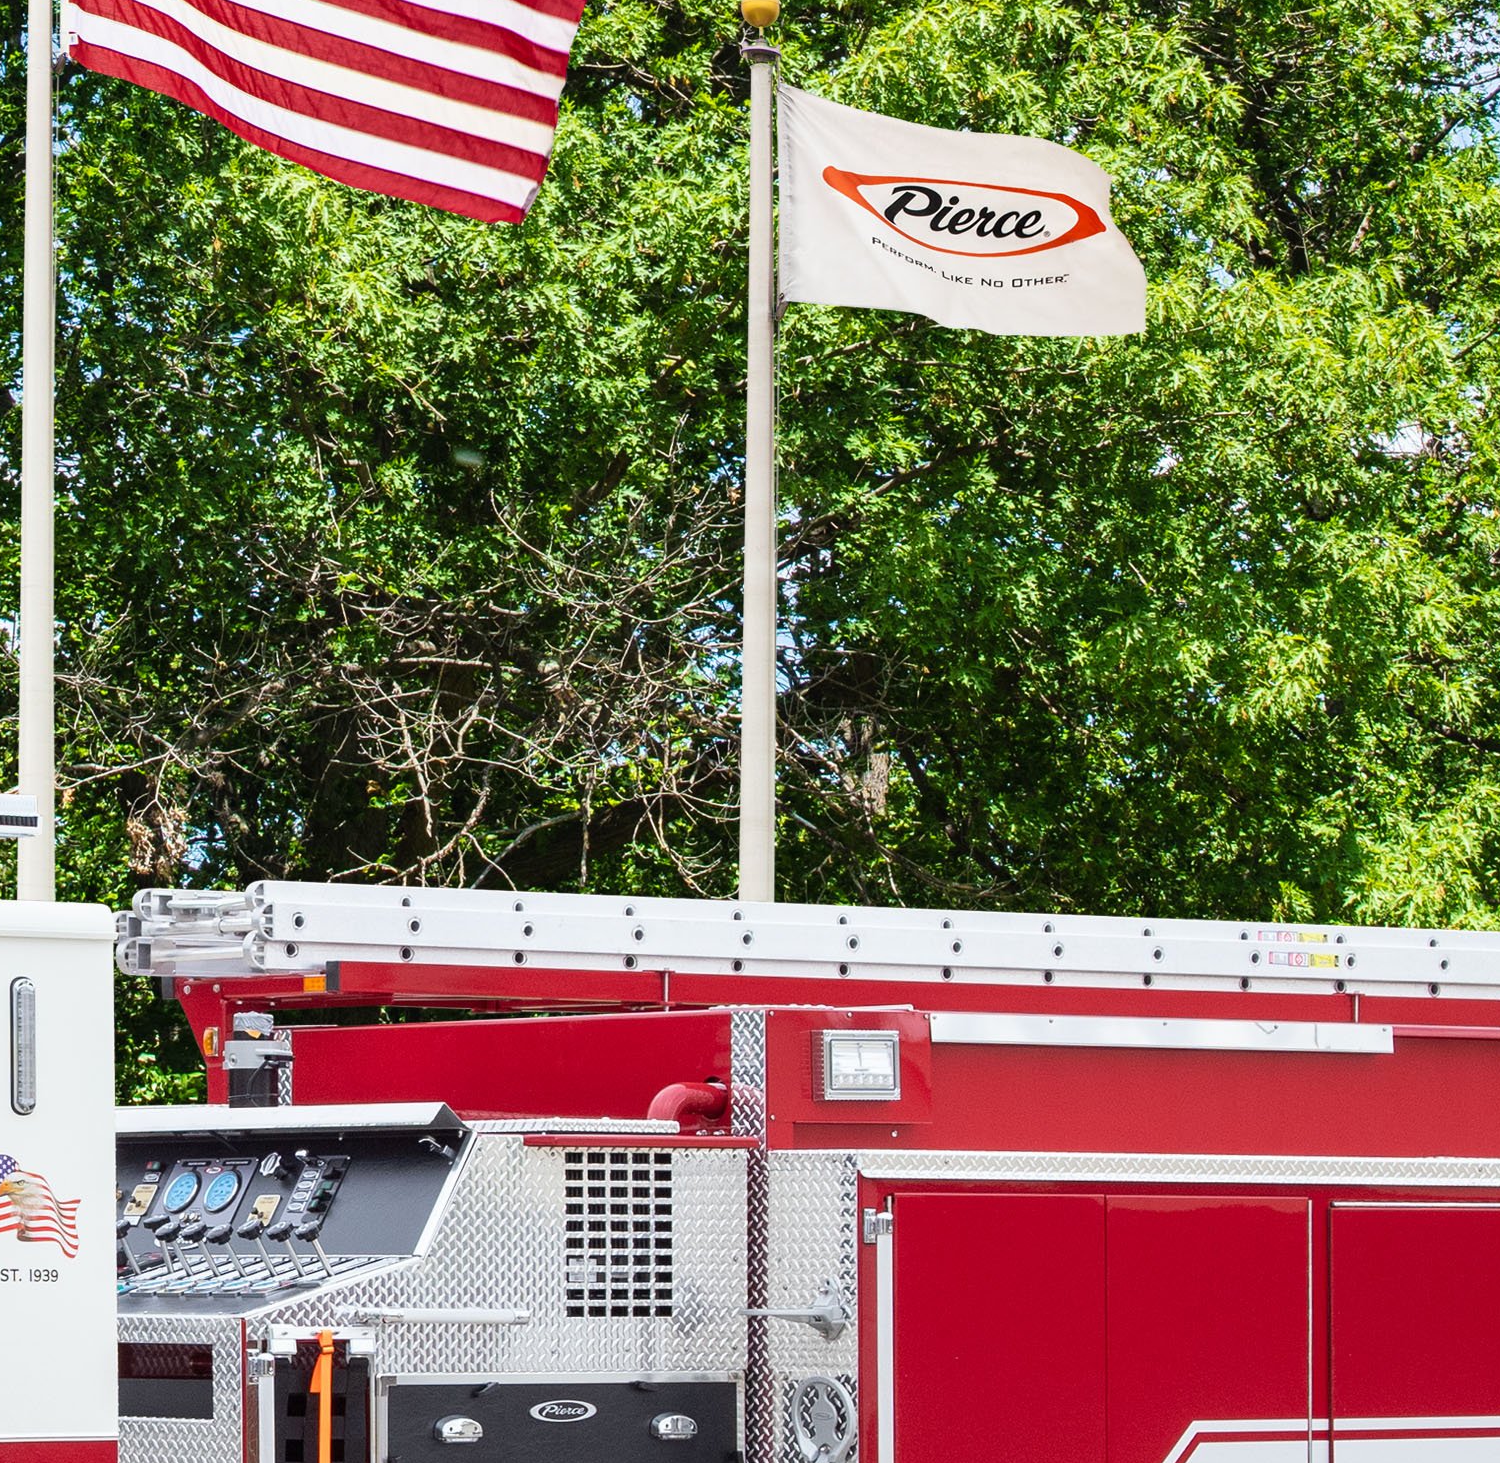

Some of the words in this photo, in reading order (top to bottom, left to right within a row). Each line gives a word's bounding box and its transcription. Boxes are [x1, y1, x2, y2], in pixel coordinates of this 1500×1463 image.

[884, 185, 1046, 239] Pierce
[29, 1268, 59, 1282] 1939
[542, 1404, 586, 1417] Pierce
